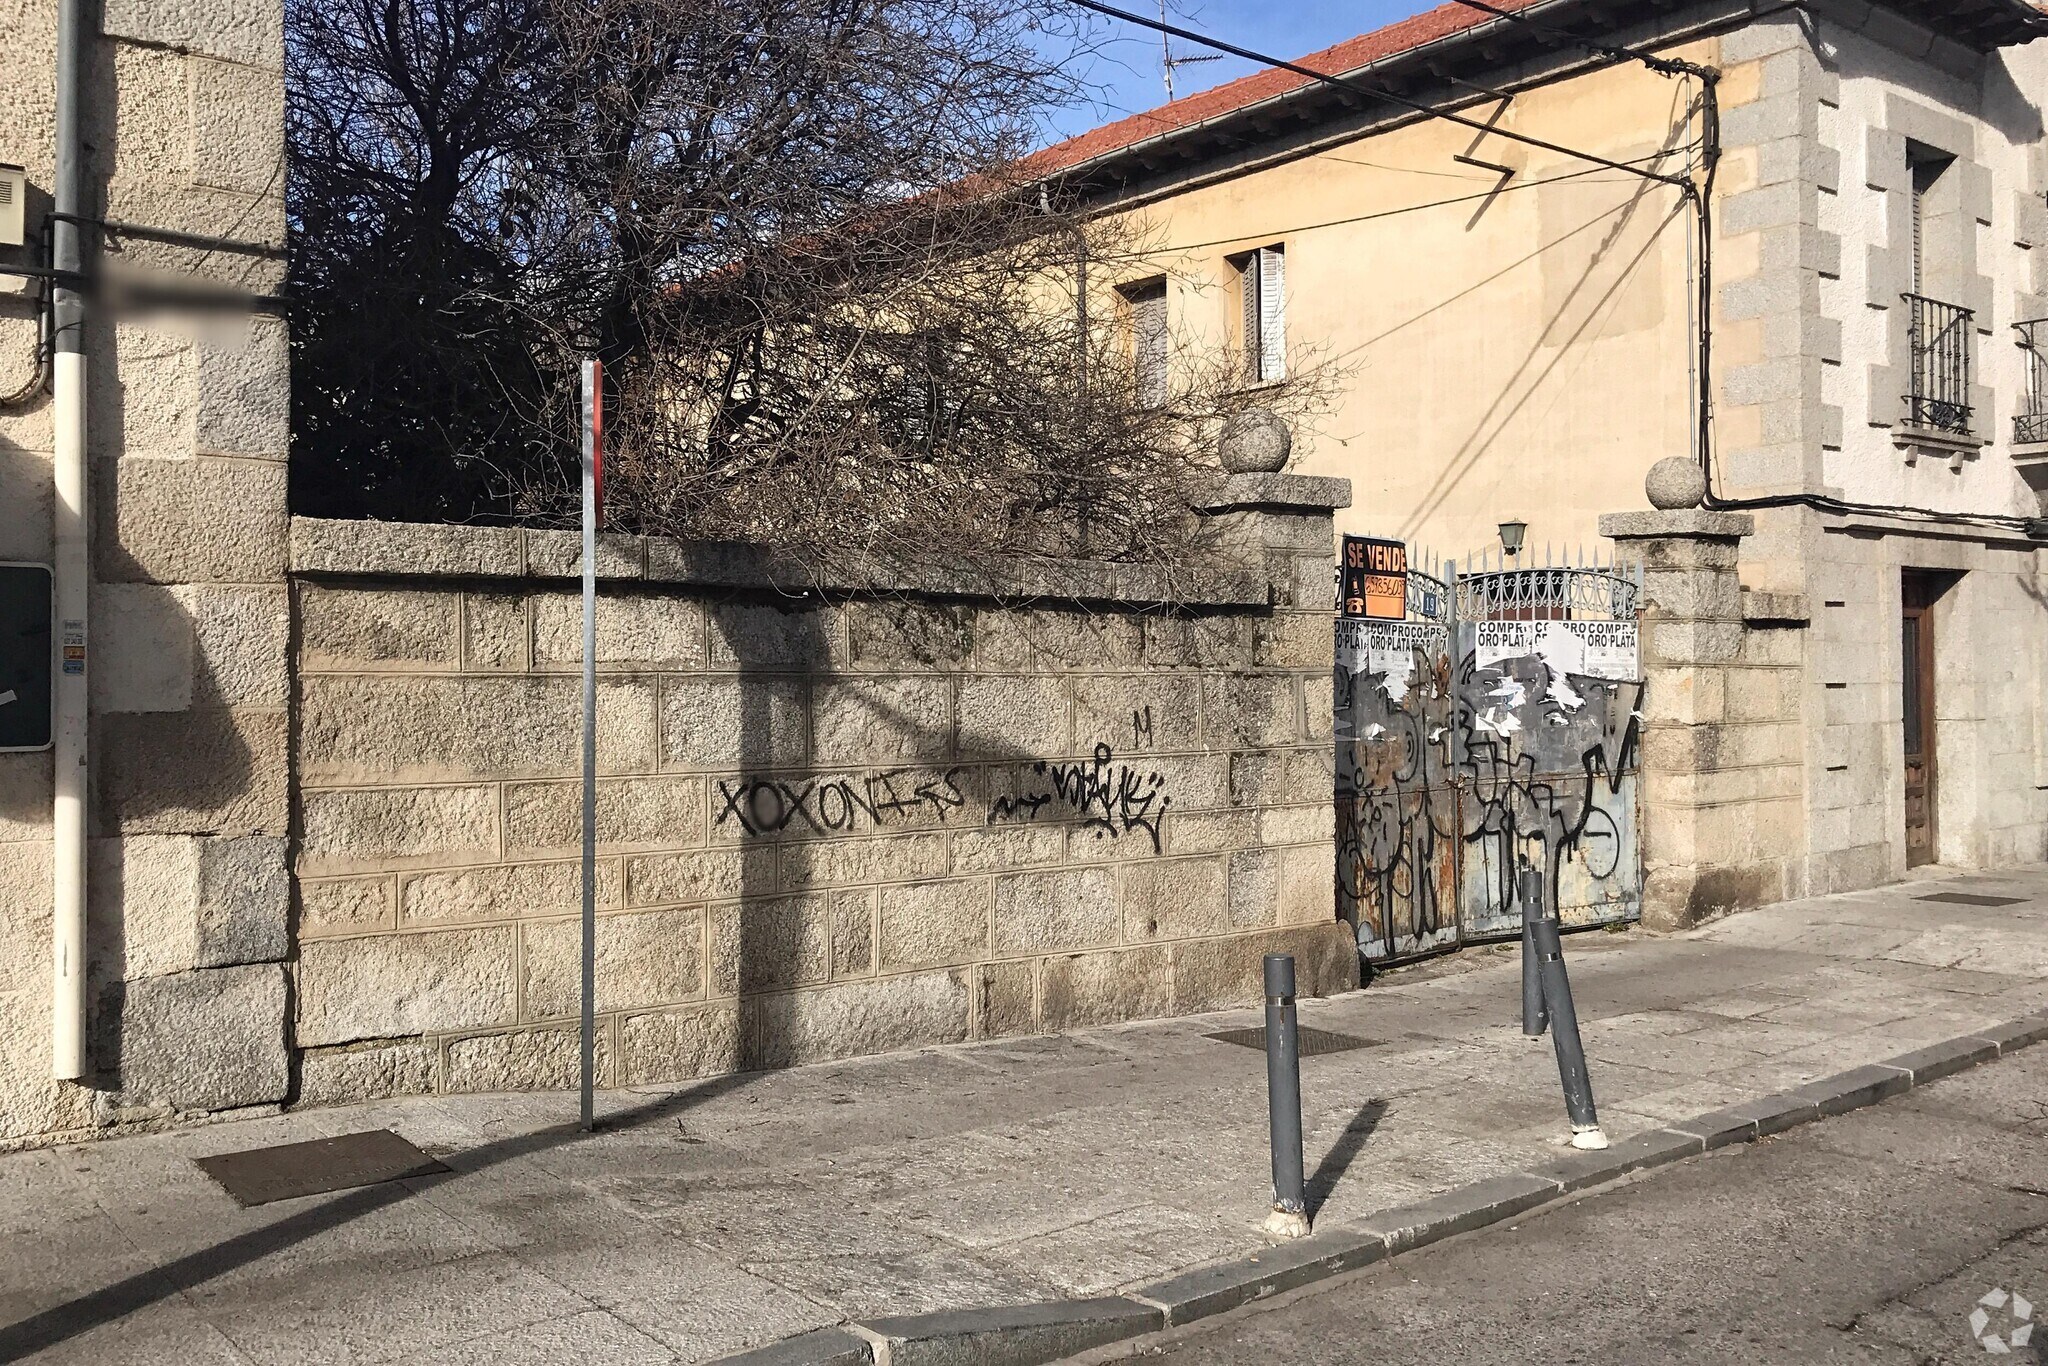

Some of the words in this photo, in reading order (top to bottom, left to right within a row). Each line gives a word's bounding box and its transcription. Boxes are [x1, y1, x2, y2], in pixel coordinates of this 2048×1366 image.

[1347, 542, 1364, 568] SE
[1367, 545, 1406, 572] VENDE
[1334, 621, 1361, 634] OMPR
[1370, 623, 1410, 637] COMPRO
[1479, 622, 1527, 633] COMPR
[1535, 622, 1586, 633] CPRO
[1371, 635, 1385, 650] ORO
[1387, 637, 1410, 652] PLATA
[1478, 634, 1499, 646] ORO
[1588, 634, 1607, 647] ORO
[1610, 635, 1635, 648] PLATA
